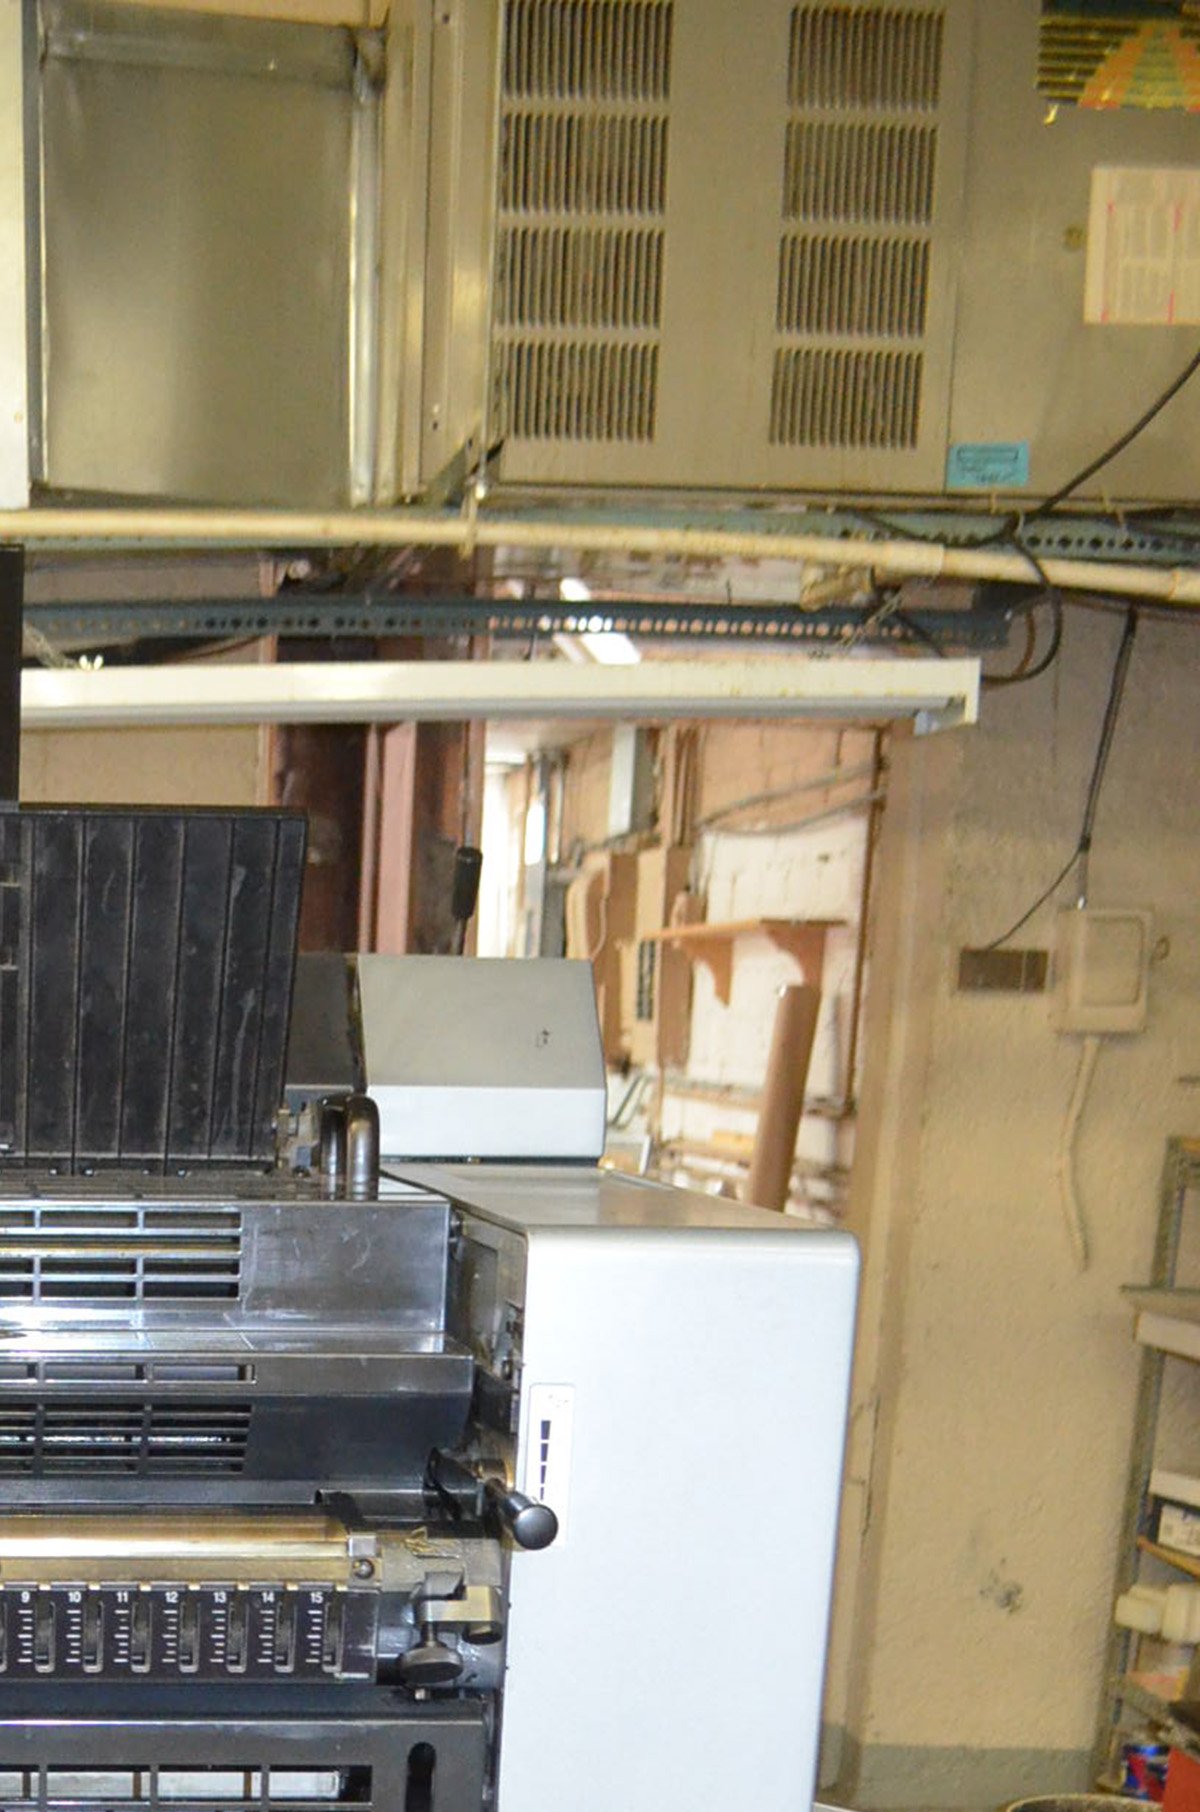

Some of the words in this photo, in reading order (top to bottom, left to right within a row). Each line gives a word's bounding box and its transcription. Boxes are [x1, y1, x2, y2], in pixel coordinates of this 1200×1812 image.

[21, 1591, 31, 1604] 9
[67, 1591, 82, 1604] 10
[116, 1591, 129, 1604] 11
[165, 1591, 179, 1604] 12
[213, 1591, 227, 1604] 13
[262, 1591, 275, 1604] 14
[310, 1591, 323, 1604] 15
